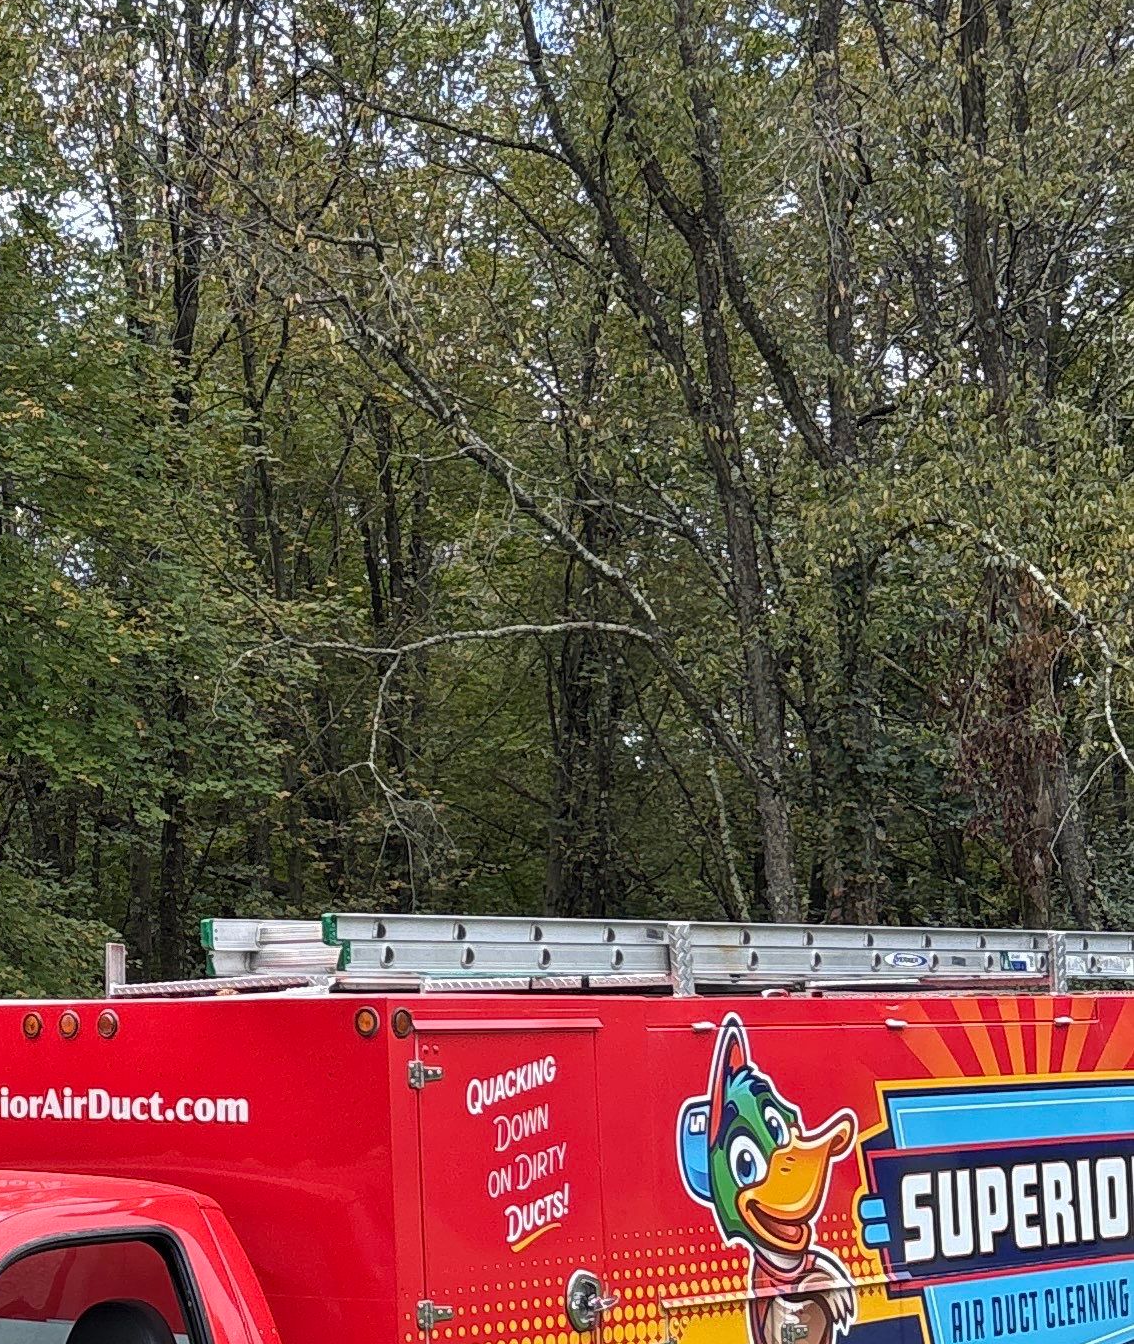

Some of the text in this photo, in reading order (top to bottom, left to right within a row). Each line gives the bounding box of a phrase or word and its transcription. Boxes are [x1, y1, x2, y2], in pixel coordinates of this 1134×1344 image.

[466, 1055, 557, 1115] QUACKING
[492, 1103, 549, 1152] DOWN
[487, 1142, 567, 1199] ON DIRTY
[504, 1182, 570, 1243] DUCTS!
[901, 1156, 1134, 1263] SUPERIO
[951, 1278, 1130, 1344] AIR DUCT CLEANING
